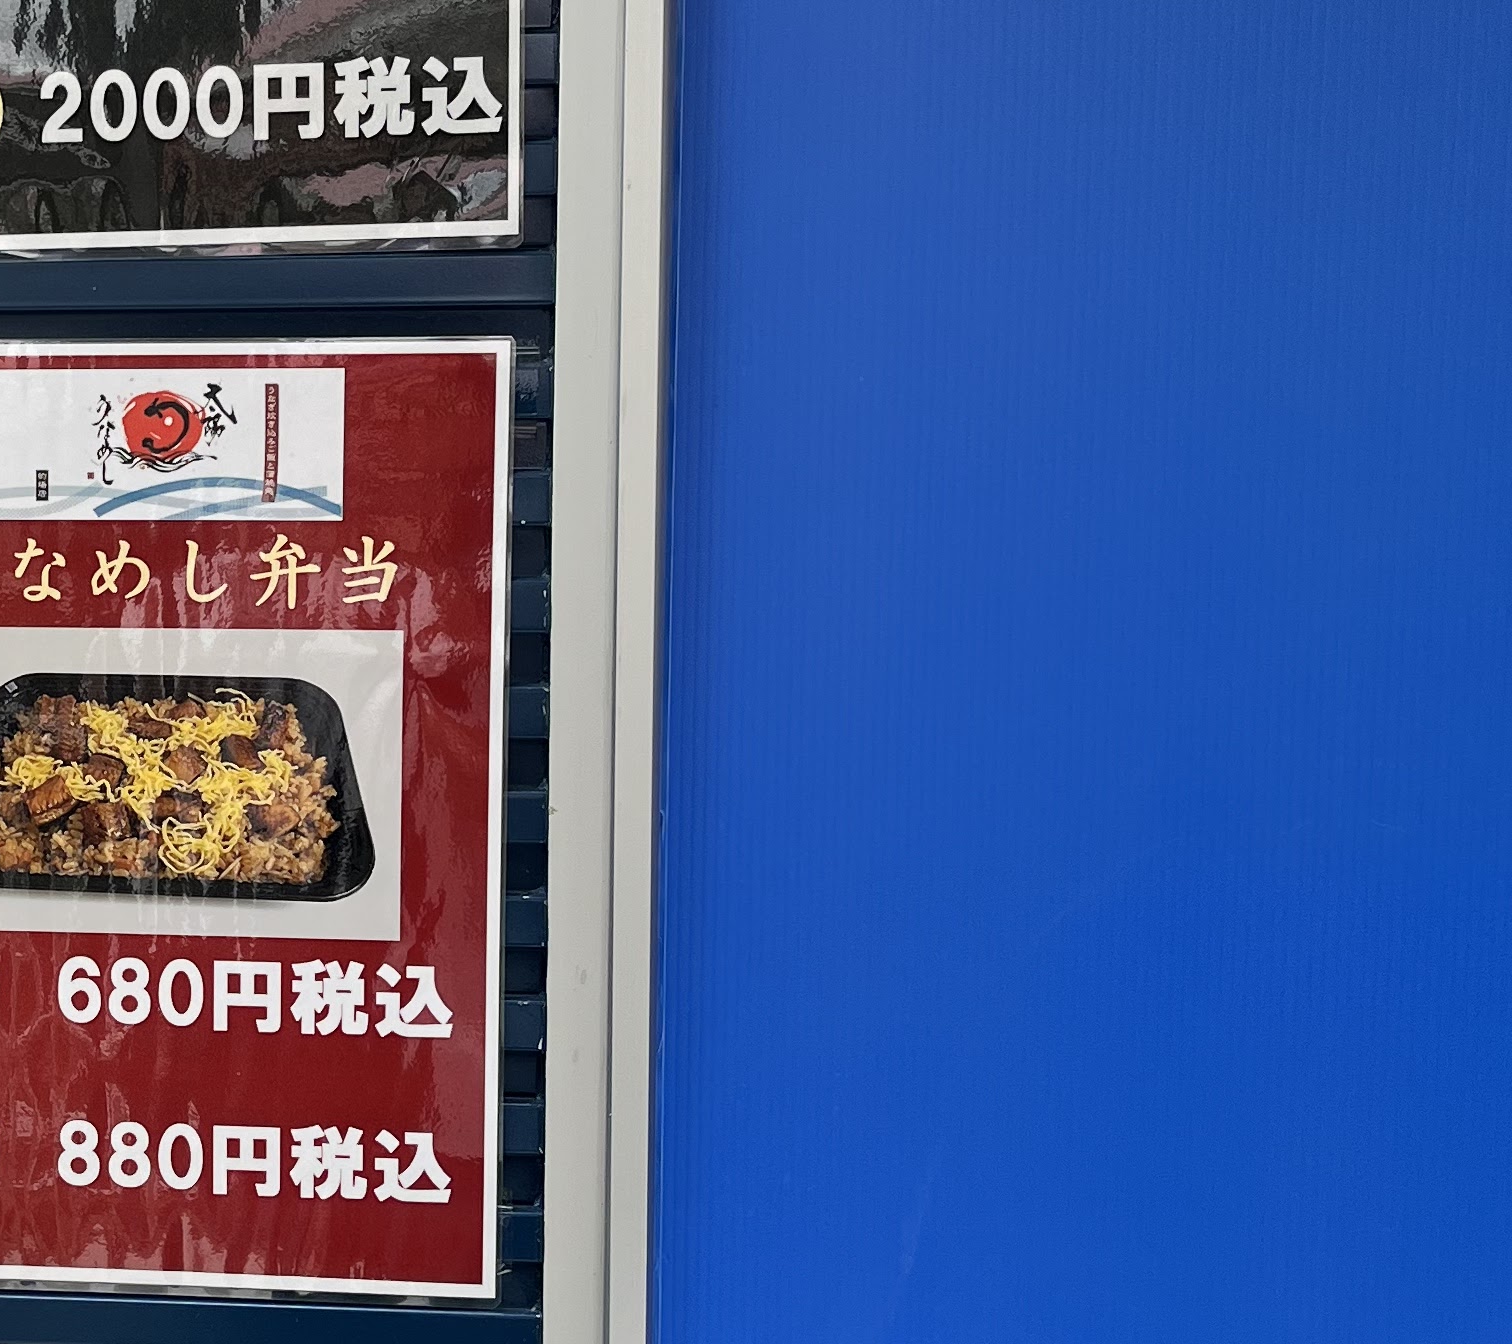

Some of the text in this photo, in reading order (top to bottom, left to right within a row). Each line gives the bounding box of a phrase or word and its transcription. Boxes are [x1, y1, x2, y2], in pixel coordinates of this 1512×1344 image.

[39, 55, 503, 145] 2000円税込
[56, 955, 454, 1039] 680円税込
[56, 1118, 452, 1203] 880円税込
